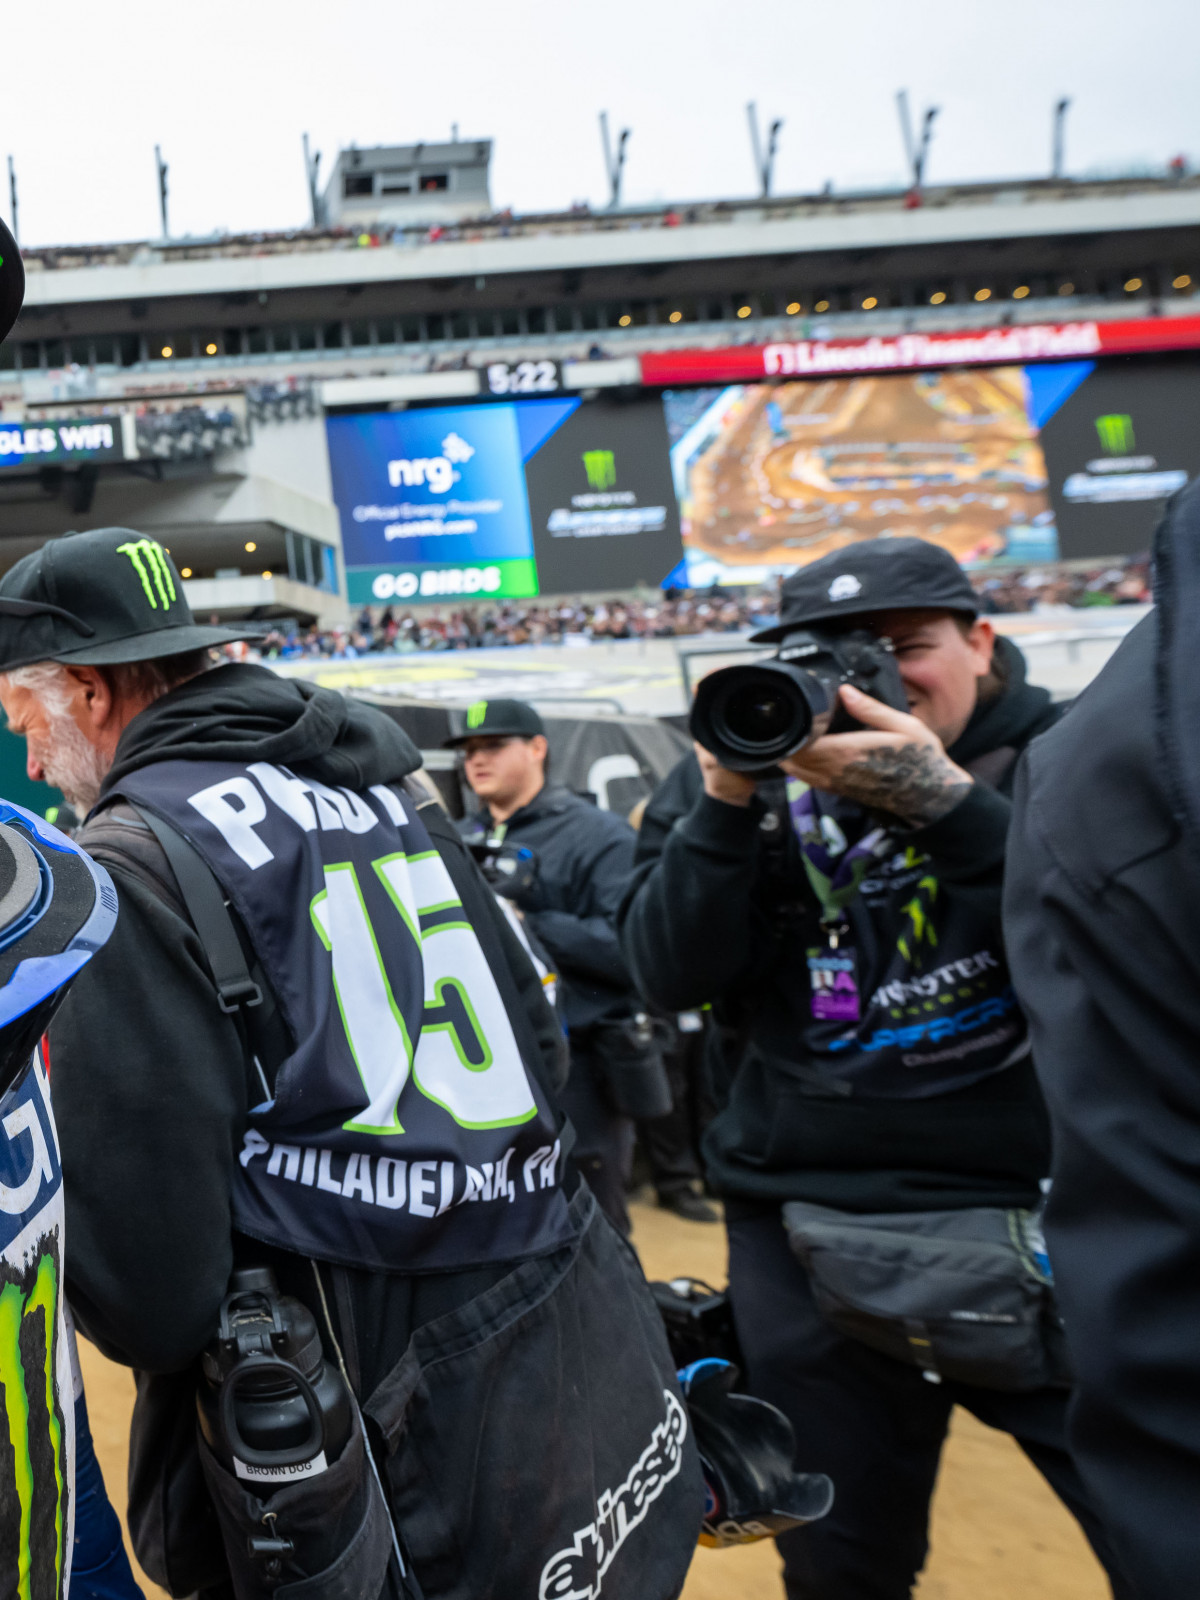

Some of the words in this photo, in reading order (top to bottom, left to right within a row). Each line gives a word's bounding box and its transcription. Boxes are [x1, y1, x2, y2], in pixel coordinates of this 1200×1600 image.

[488, 360, 558, 394] 5:22
[387, 456, 454, 494] nrg
[372, 572, 419, 599] GO
[420, 566, 502, 596] BIRDS
[310, 850, 539, 1135] 15
[521, 1138, 561, 1193] PA
[246, 1464, 286, 1476] BROWN
[289, 1462, 312, 1474] DOG
